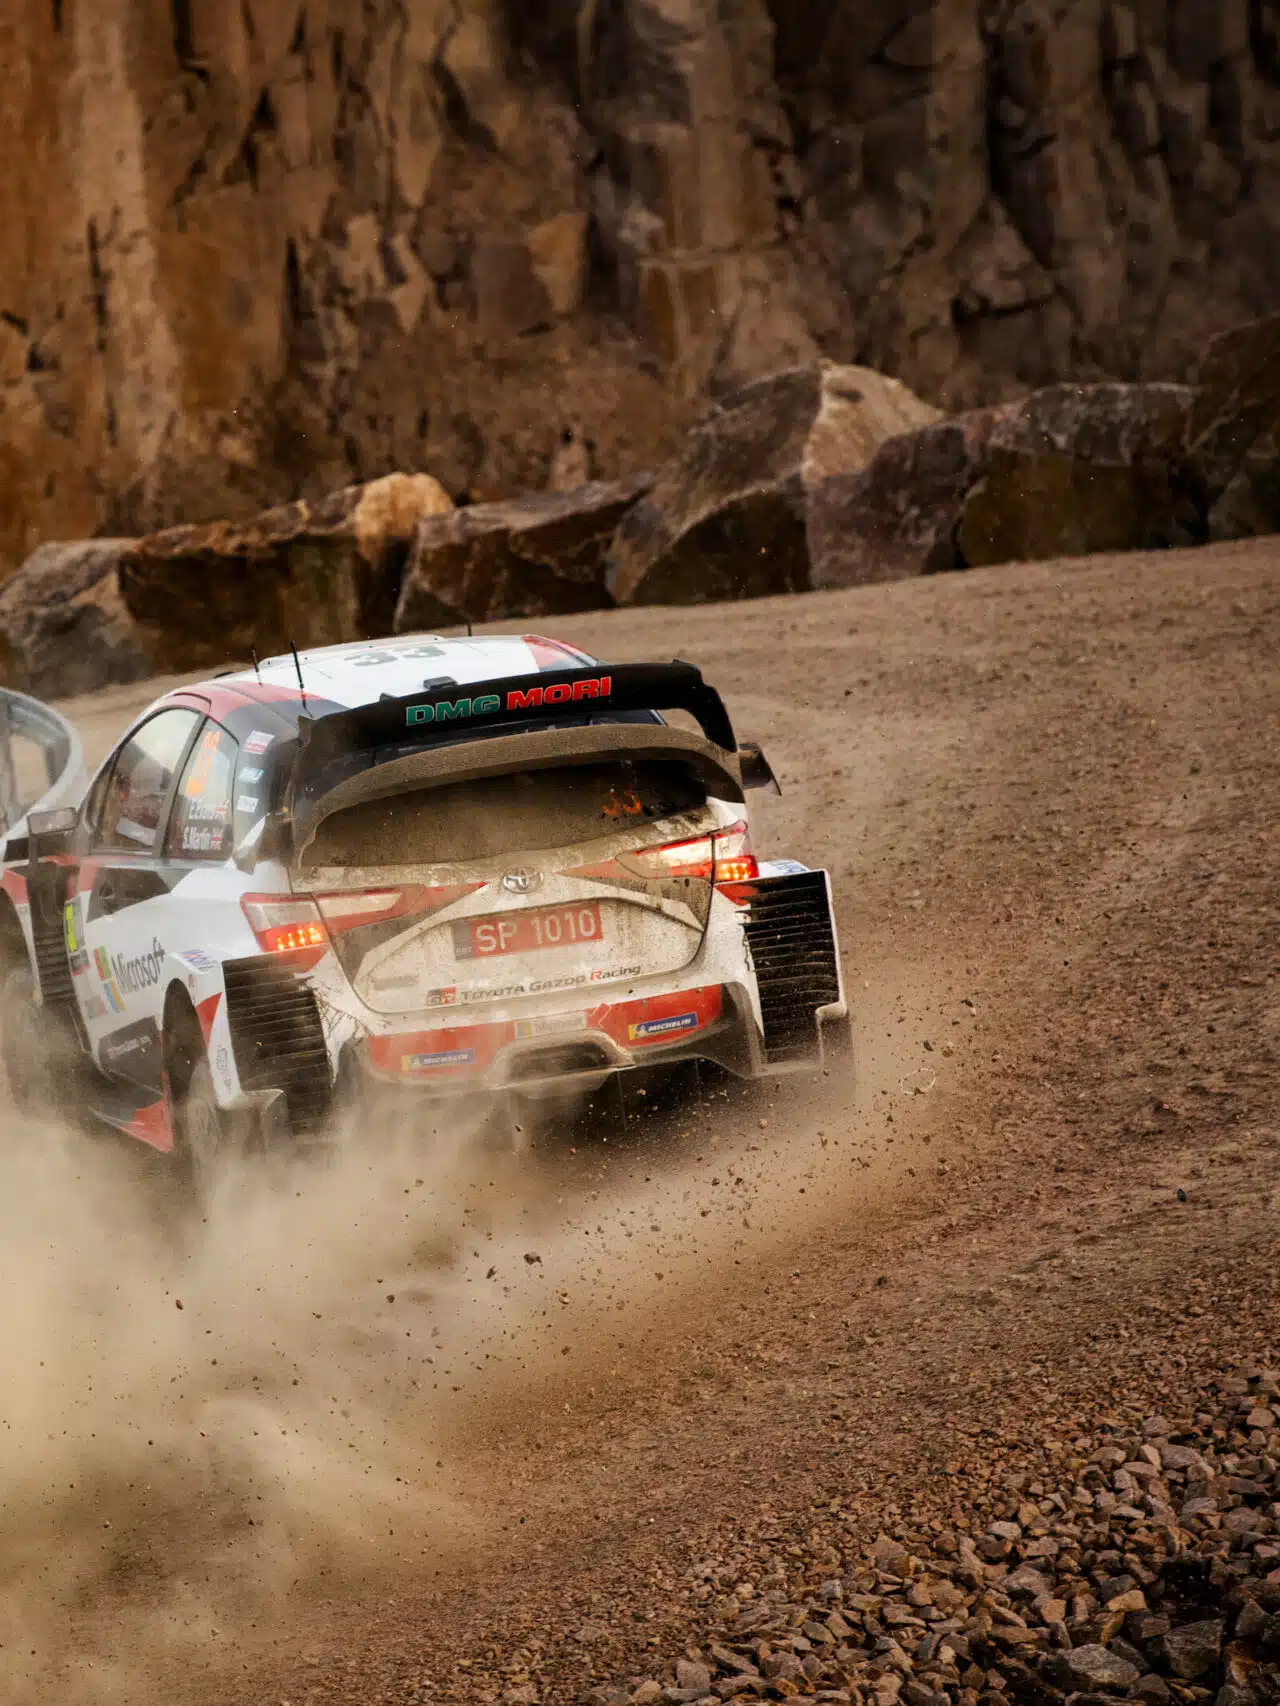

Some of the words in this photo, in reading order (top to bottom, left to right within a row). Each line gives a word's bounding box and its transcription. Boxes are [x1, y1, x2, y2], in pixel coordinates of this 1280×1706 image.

[343, 645, 446, 667] 33
[406, 694, 500, 727] DMG
[507, 676, 612, 710] MORI
[475, 919, 518, 952] SP
[531, 908, 597, 946] 1010
[111, 936, 166, 996] Microsoft
[460, 984, 525, 1002] TOYOTA
[590, 964, 642, 982] Racing
[646, 1017, 692, 1033] MICHELIN
